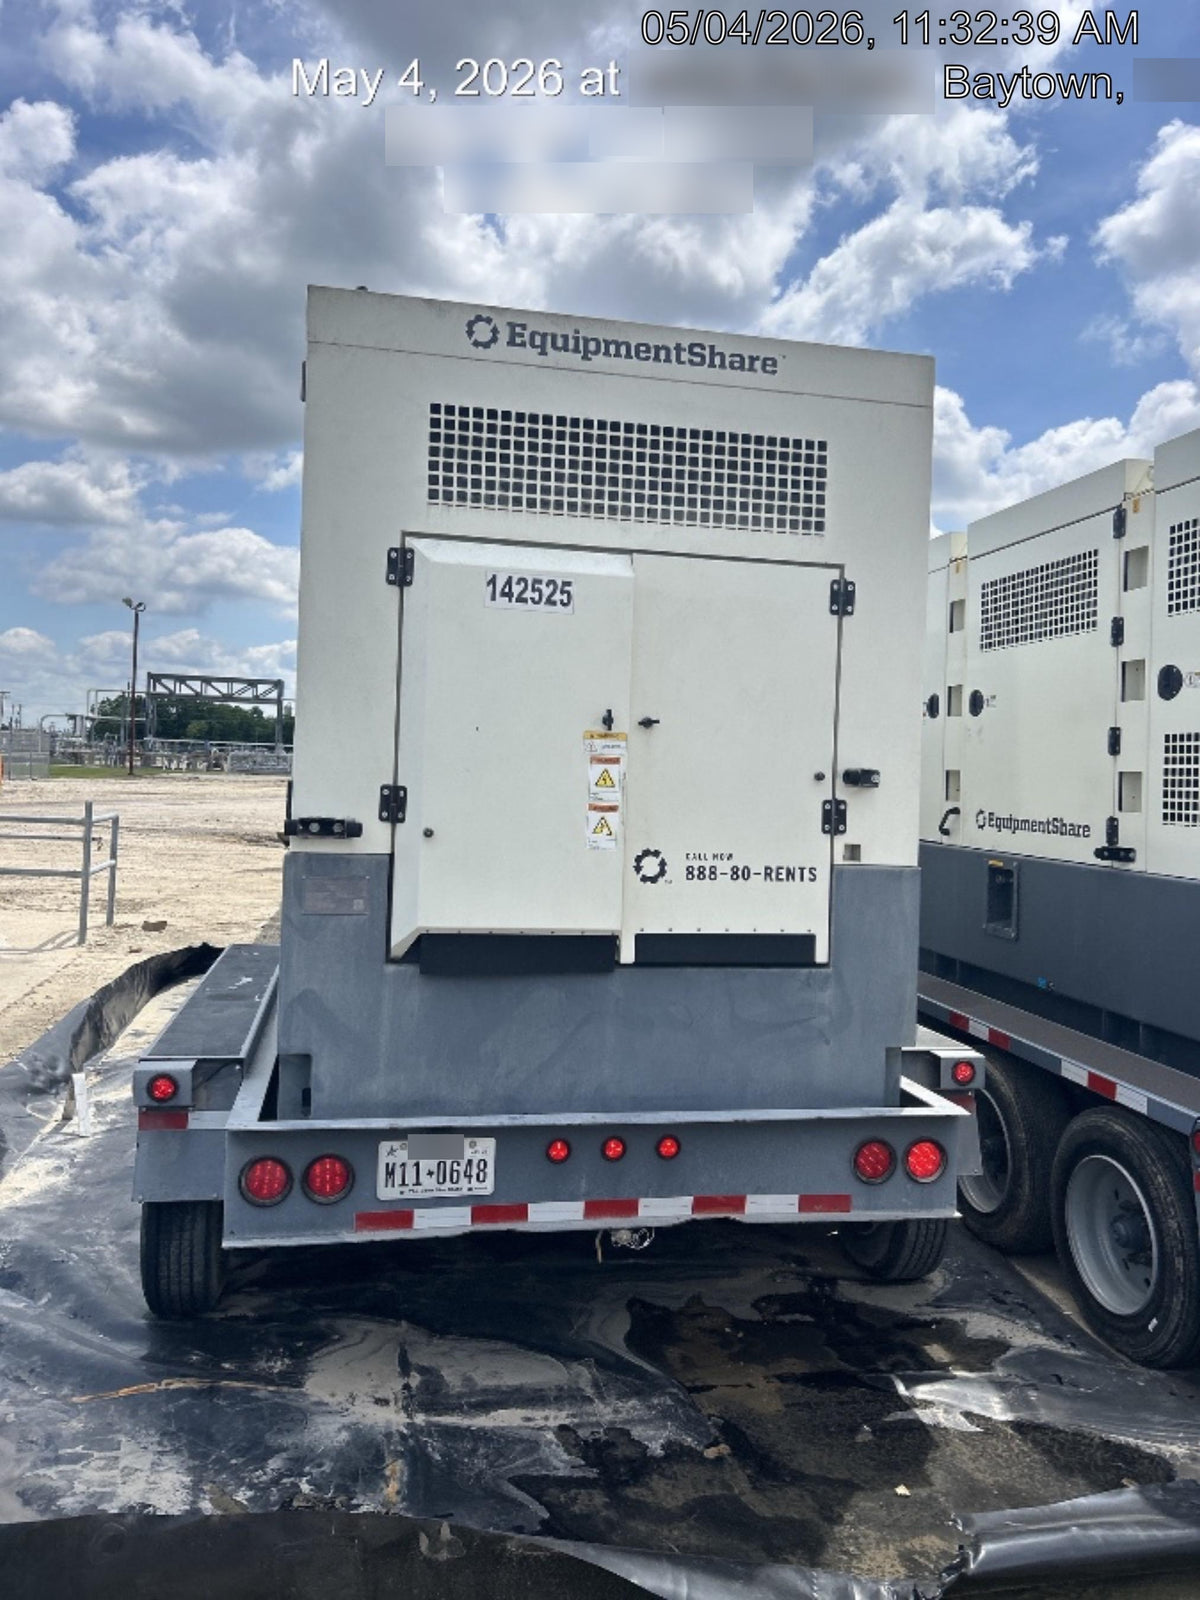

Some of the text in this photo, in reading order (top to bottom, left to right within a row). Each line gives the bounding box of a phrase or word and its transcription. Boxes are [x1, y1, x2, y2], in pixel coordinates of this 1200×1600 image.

[506, 321, 778, 375] EquipmentShare
[486, 573, 573, 607] 142525
[988, 812, 1091, 838] EquipmentShare
[685, 853, 708, 861] CALL
[685, 865, 818, 882] 888-80-RENTS
